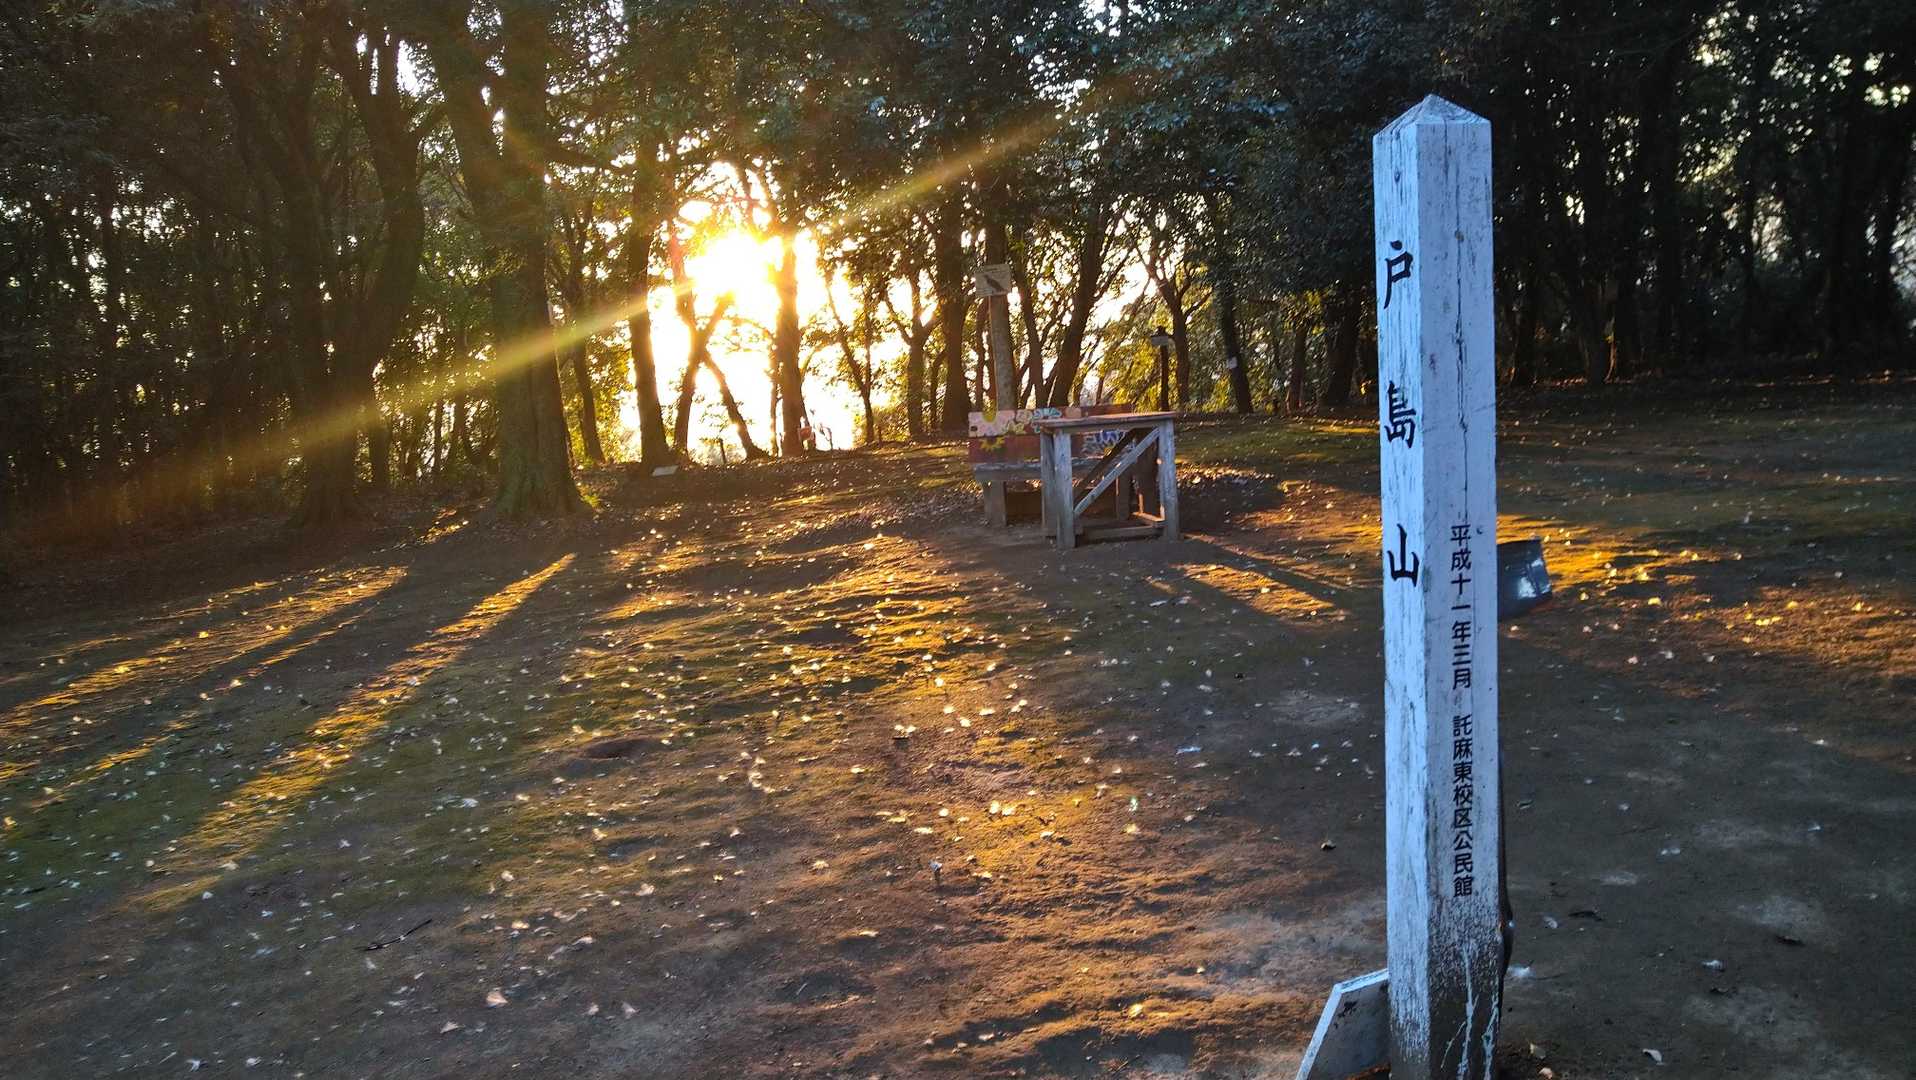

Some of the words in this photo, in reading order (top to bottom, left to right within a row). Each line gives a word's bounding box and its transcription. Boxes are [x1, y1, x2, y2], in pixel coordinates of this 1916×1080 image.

[1450, 524, 1472, 691] 平成十一年三月
[1452, 714, 1474, 898] 託麻東校区公民館
